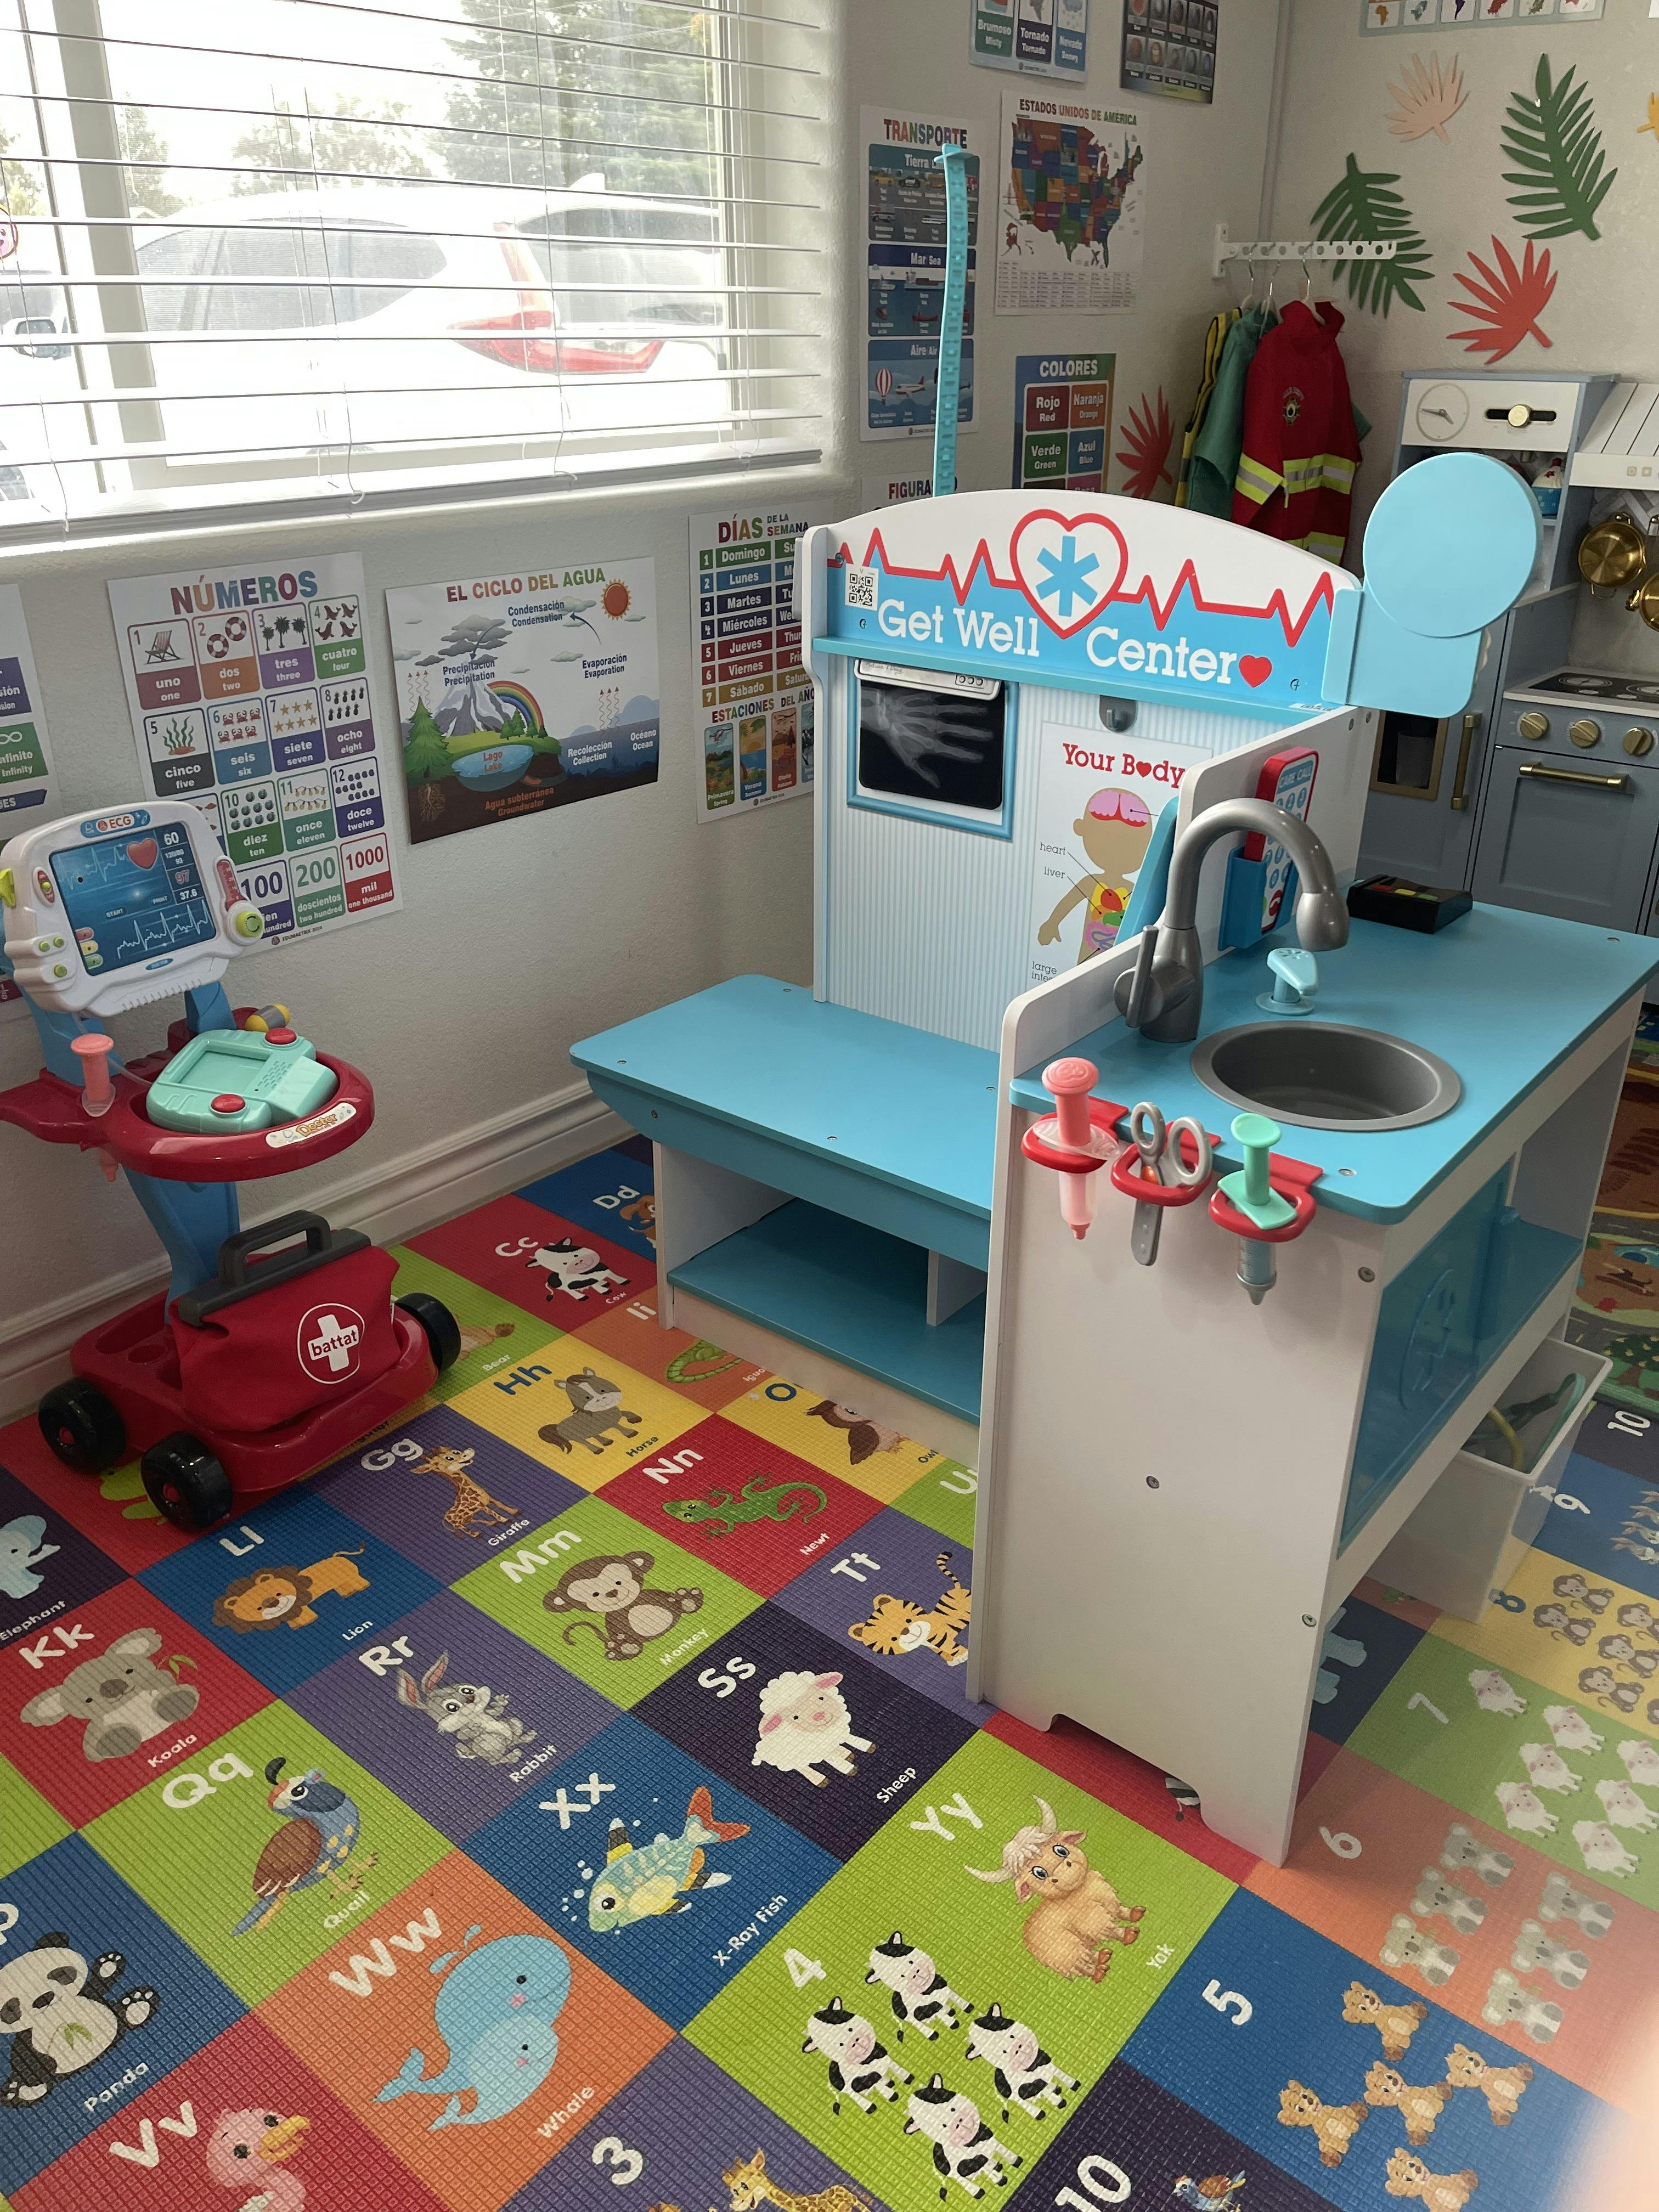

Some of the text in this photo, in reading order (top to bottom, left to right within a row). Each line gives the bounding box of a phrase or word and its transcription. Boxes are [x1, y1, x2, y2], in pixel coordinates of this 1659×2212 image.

[978, 19, 1012, 36] Brumoso
[1020, 27, 1049, 43] Tornado
[985, 36, 1002, 49] Misty
[1022, 43, 1046, 55] Tornado
[1020, 99, 1057, 115] ESTADOS
[1059, 104, 1089, 120] UNIDOS
[1091, 109, 1102, 121] DE
[884, 119, 967, 149] TRANSPORTE
[905, 154, 929, 168] Tierra
[911, 253, 941, 266] Mar Sea
[911, 345, 938, 356] Aire Air
[1040, 359, 1098, 377] COLORES
[1036, 396, 1060, 411] Rojo
[1074, 392, 1104, 407] Naranja
[1039, 413, 1056, 422] Red
[1031, 444, 1061, 457] Verde
[1077, 441, 1096, 453] Azul
[1034, 461, 1057, 470] Green
[1079, 456, 1093, 465] Blue
[889, 479, 933, 499] FIGURA
[718, 514, 763, 543] DÍAS
[767, 515, 777, 523] DE
[767, 522, 809, 537] SEMANA
[721, 547, 765, 562] Domingo
[446, 567, 606, 602] EL CICLO DEL AGUA
[729, 572, 759, 585] Lunes
[171, 571, 318, 615] NÚMEROS
[508, 600, 565, 617] Condensación
[727, 595, 761, 610] Martes
[512, 613, 563, 627] Condensation
[723, 616, 768, 633] Miércoles
[730, 639, 762, 654] Jueves
[878, 599, 1237, 684] Get Well Center
[321, 647, 358, 661] cuatro
[582, 653, 627, 670] Evaporación
[274, 658, 298, 669] tres
[442, 659, 495, 676] Precipitación
[584, 664, 625, 680] Evaporation
[729, 661, 763, 676] Viernes
[219, 667, 240, 679] dos
[276, 670, 301, 682] three
[444, 670, 495, 687] Precipitation
[155, 676, 180, 690] uno
[222, 680, 241, 691] two
[730, 682, 764, 698] Sábado
[161, 690, 180, 702] one
[712, 698, 775, 723] ESTACIONES
[781, 695, 795, 707] DEL
[337, 730, 363, 743] ocho
[630, 729, 657, 742] Océano
[284, 740, 313, 754] siete
[341, 741, 363, 754] eight
[567, 740, 612, 758] Recolección
[633, 740, 653, 751] Ocean
[230, 752, 256, 765] seis
[286, 754, 314, 766] seven
[483, 749, 503, 763] Lago
[573, 752, 607, 766] Collection
[1063, 742, 1115, 772] Your
[165, 764, 201, 778] cinco
[484, 761, 503, 773] Lake
[175, 778, 195, 789] five
[744, 781, 762, 791] Verano
[484, 786, 554, 813] Agua subterránea
[707, 789, 734, 801] Primavera
[346, 806, 373, 820] doce
[498, 799, 545, 817] Groundwater
[109, 816, 132, 830] ECG
[295, 820, 323, 833] once
[347, 818, 375, 831] twelve
[164, 832, 179, 845] 60
[243, 833, 268, 845] diez
[296, 831, 325, 845] eleven
[1039, 842, 1066, 856] heart
[345, 845, 384, 871] 1000
[175, 869, 190, 884] 97
[295, 856, 336, 888] 200
[1043, 866, 1065, 879] liver
[241, 871, 283, 900] 100
[360, 881, 377, 894] mil
[179, 889, 198, 900] 37.6
[297, 893, 341, 912] doscientos
[348, 890, 393, 909] one thousand
[106, 909, 123, 918] START
[314, 904, 342, 919] hundred
[1032, 961, 1057, 974] large
[296, 1114, 337, 1137] Doctor
[592, 1185, 640, 1209] Dd
[495, 1237, 538, 1258] Cc
[606, 1290, 627, 1305] Cow
[311, 1330, 357, 1357] battat
[482, 1352, 511, 1372] Bear
[494, 1364, 552, 1396] Hh
[1607, 1410, 1651, 1437] 10
[625, 1435, 658, 1457] Horse
[360, 1438, 424, 1473] Gg
[642, 1448, 704, 1483] Nn
[1554, 1493, 1590, 1514] 9
[488, 1517, 530, 1547] Giraffe
[799, 1532, 830, 1556] Newt
[499, 1529, 582, 1583] Mm
[830, 1551, 881, 1582] Tt
[1488, 1589, 1527, 1613] 8
[0, 1599, 66, 1640] Elephant
[341, 1619, 373, 1642] Lion
[18, 1623, 95, 1669] Kk
[659, 1627, 710, 1667] Monkey
[358, 1635, 419, 1677] Rr
[697, 1656, 757, 1698] Ss
[1407, 1692, 1449, 1724] 7
[146, 1734, 198, 1768] Koala
[509, 1744, 557, 1782] Rabbit
[162, 1752, 254, 1809] Qq
[876, 1765, 916, 1804] Sheep
[538, 1772, 616, 1830] Xx
[909, 1791, 983, 1842] Yy
[1319, 1825, 1363, 1860] 6
[323, 1890, 370, 1930] Quail
[712, 1894, 789, 1967] X-Ray Fish
[329, 1907, 442, 1997] Ww
[1146, 1942, 1175, 1970] Yak
[783, 1948, 827, 1989] 4
[1202, 1979, 1253, 2027] 5
[83, 2062, 149, 2113] Panda
[537, 2085, 596, 2138] Whale
[109, 2100, 198, 2169] Vv
[591, 2136, 644, 2186] 3
[1055, 2153, 1132, 2212] 10
